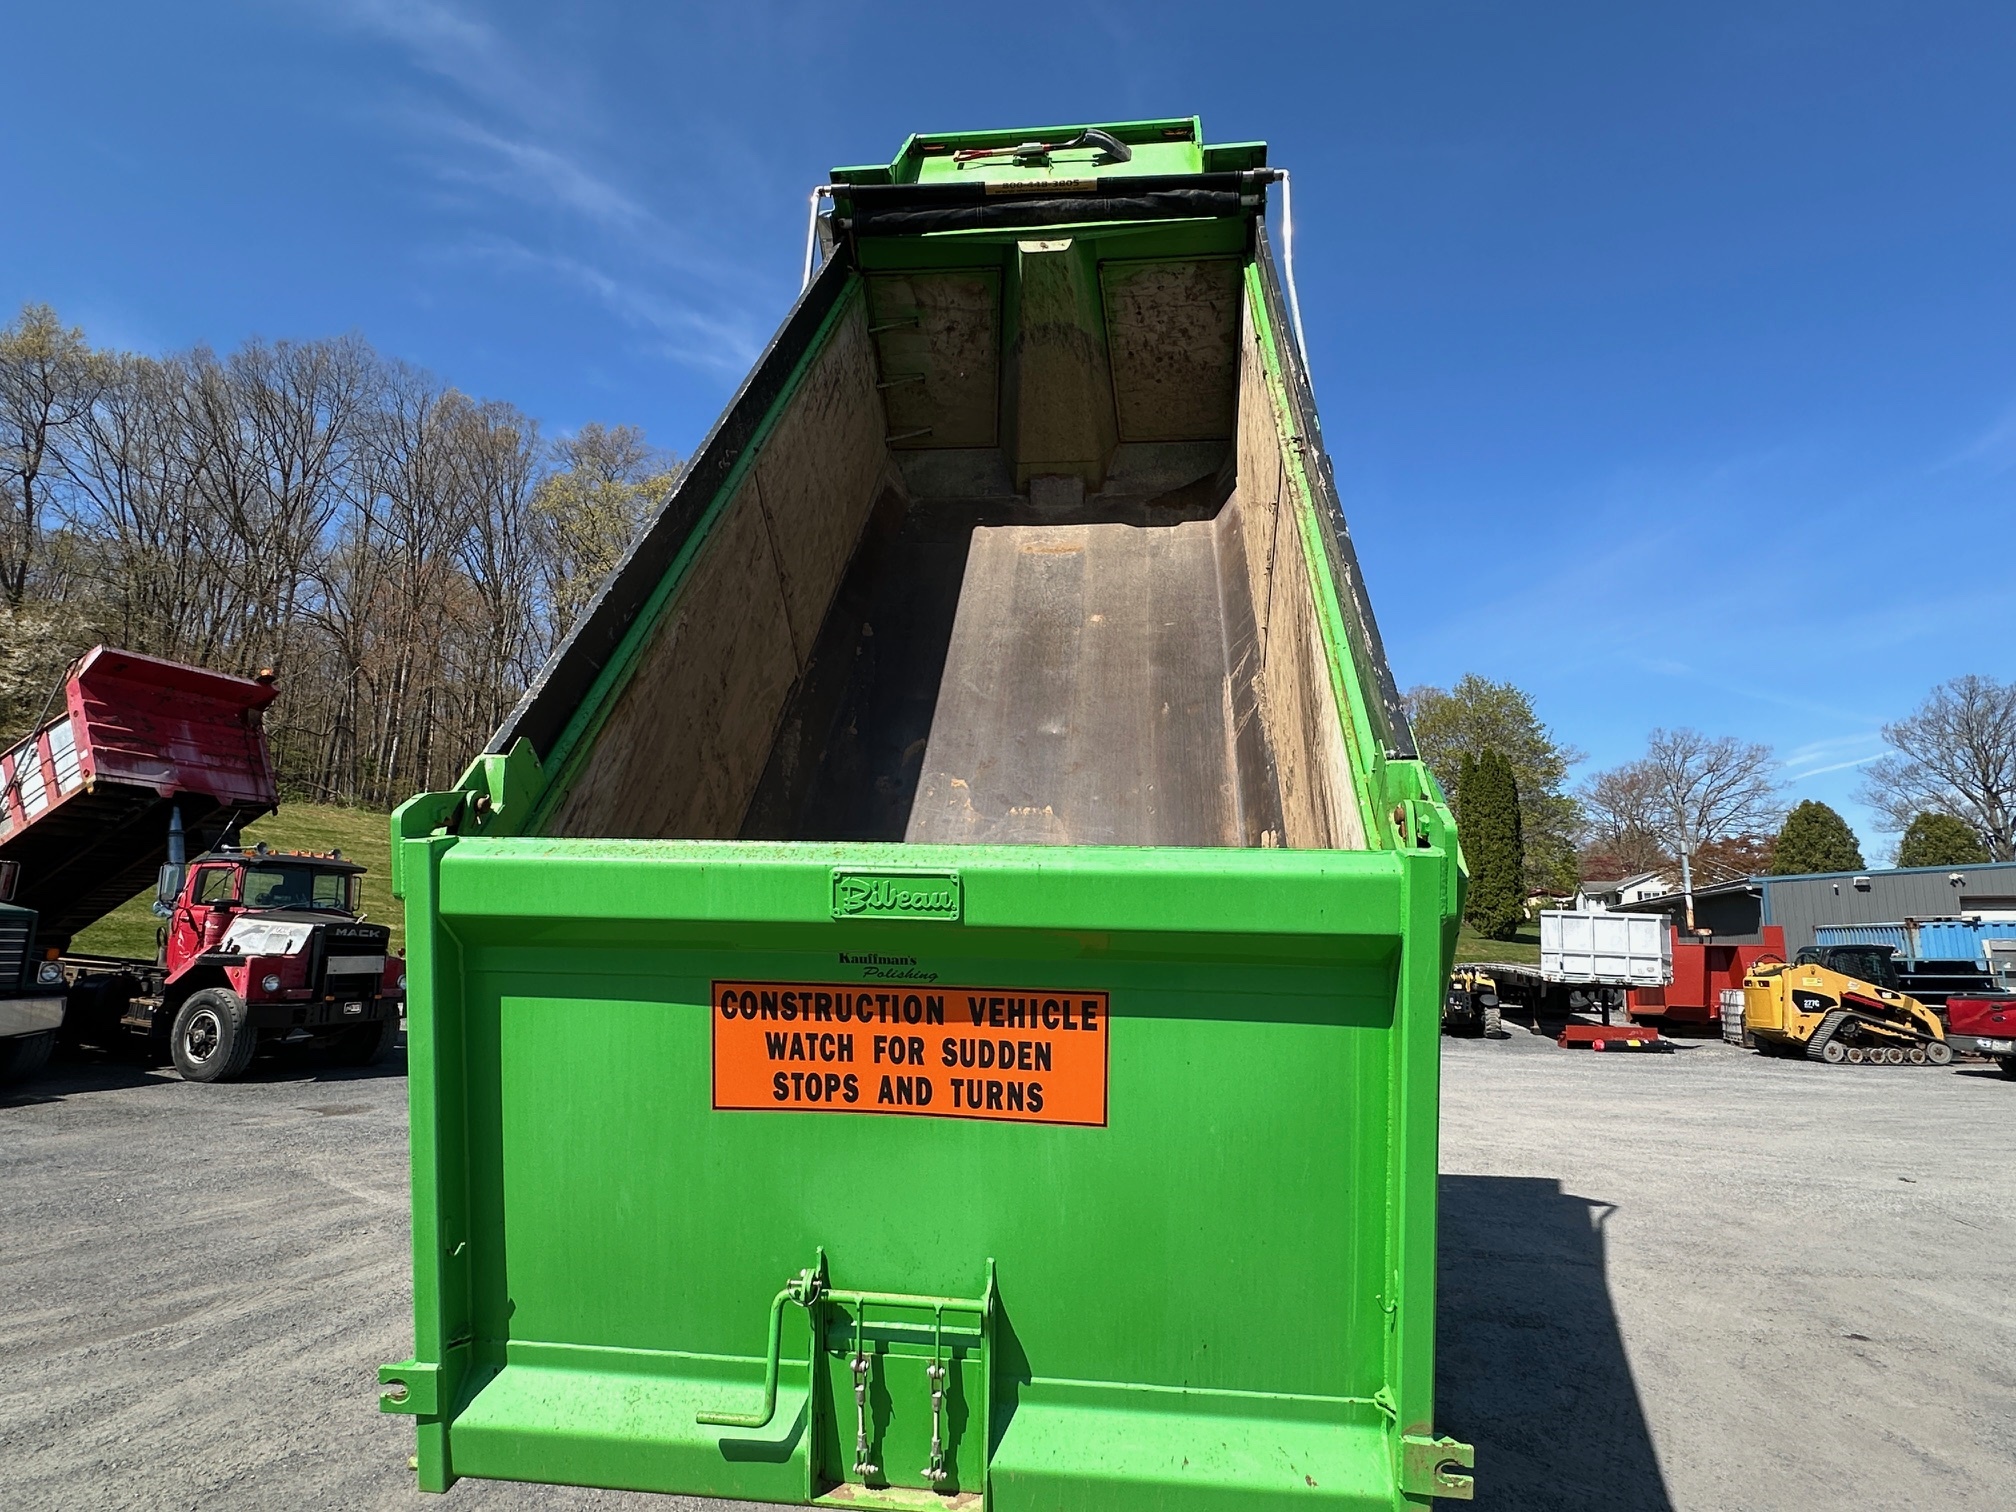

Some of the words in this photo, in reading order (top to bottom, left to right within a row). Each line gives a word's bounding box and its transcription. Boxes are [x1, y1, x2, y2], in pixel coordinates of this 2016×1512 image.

[840, 876, 953, 915] Bibeau
[335, 928, 381, 938] MACK
[838, 952, 918, 966] Kauffman's
[862, 966, 940, 983] Polishing
[720, 989, 945, 1026] CONSTRUCTION
[967, 996, 1099, 1032] VEHICLE
[765, 1031, 854, 1062] WATCH
[873, 1035, 925, 1066] FOR
[941, 1037, 1052, 1071] SUDDEN
[772, 1071, 860, 1103] STOPS
[877, 1075, 933, 1106] AND
[950, 1078, 1044, 1113] TURNS
